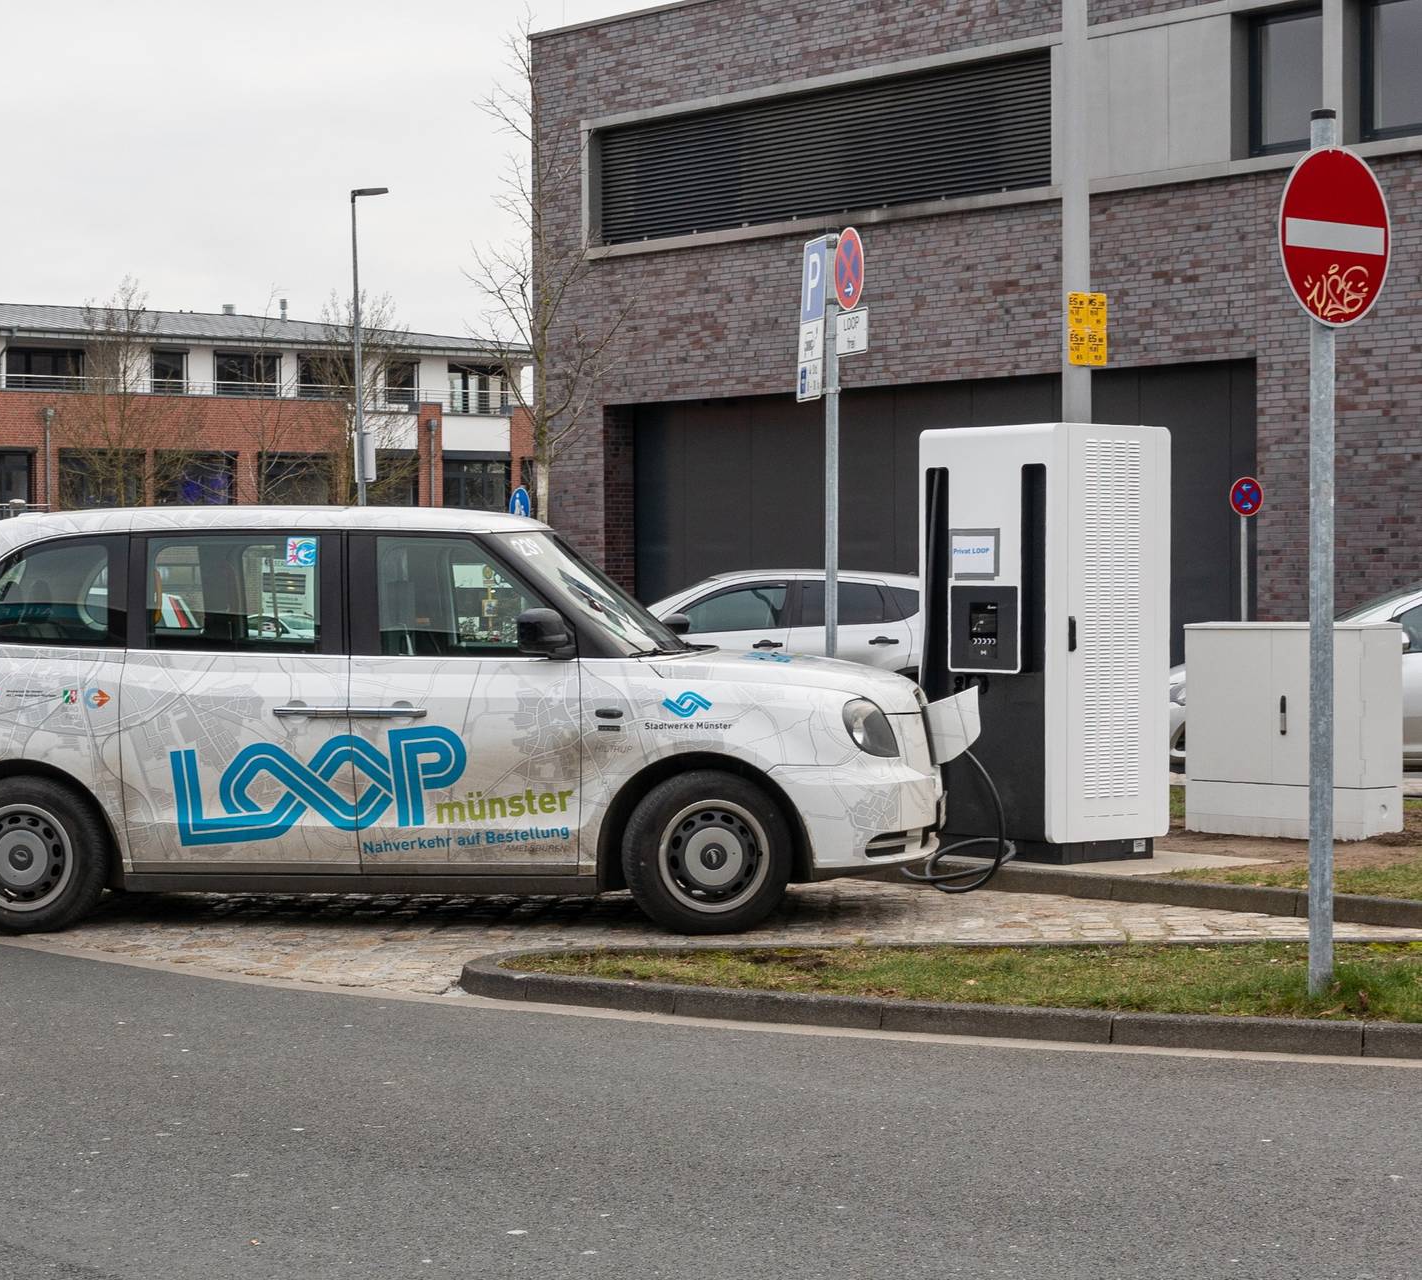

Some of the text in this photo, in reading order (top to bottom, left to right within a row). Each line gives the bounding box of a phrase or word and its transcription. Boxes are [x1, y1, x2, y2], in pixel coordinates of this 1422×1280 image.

[807, 252, 821, 312] P
[844, 316, 860, 332] LOOP
[953, 547, 971, 555] Privat
[644, 722, 732, 730] Stadtwerke Münster
[170, 725, 467, 846] LOOP
[435, 787, 574, 824] münster
[363, 826, 570, 855] Nahverkehr auf Bestellung
